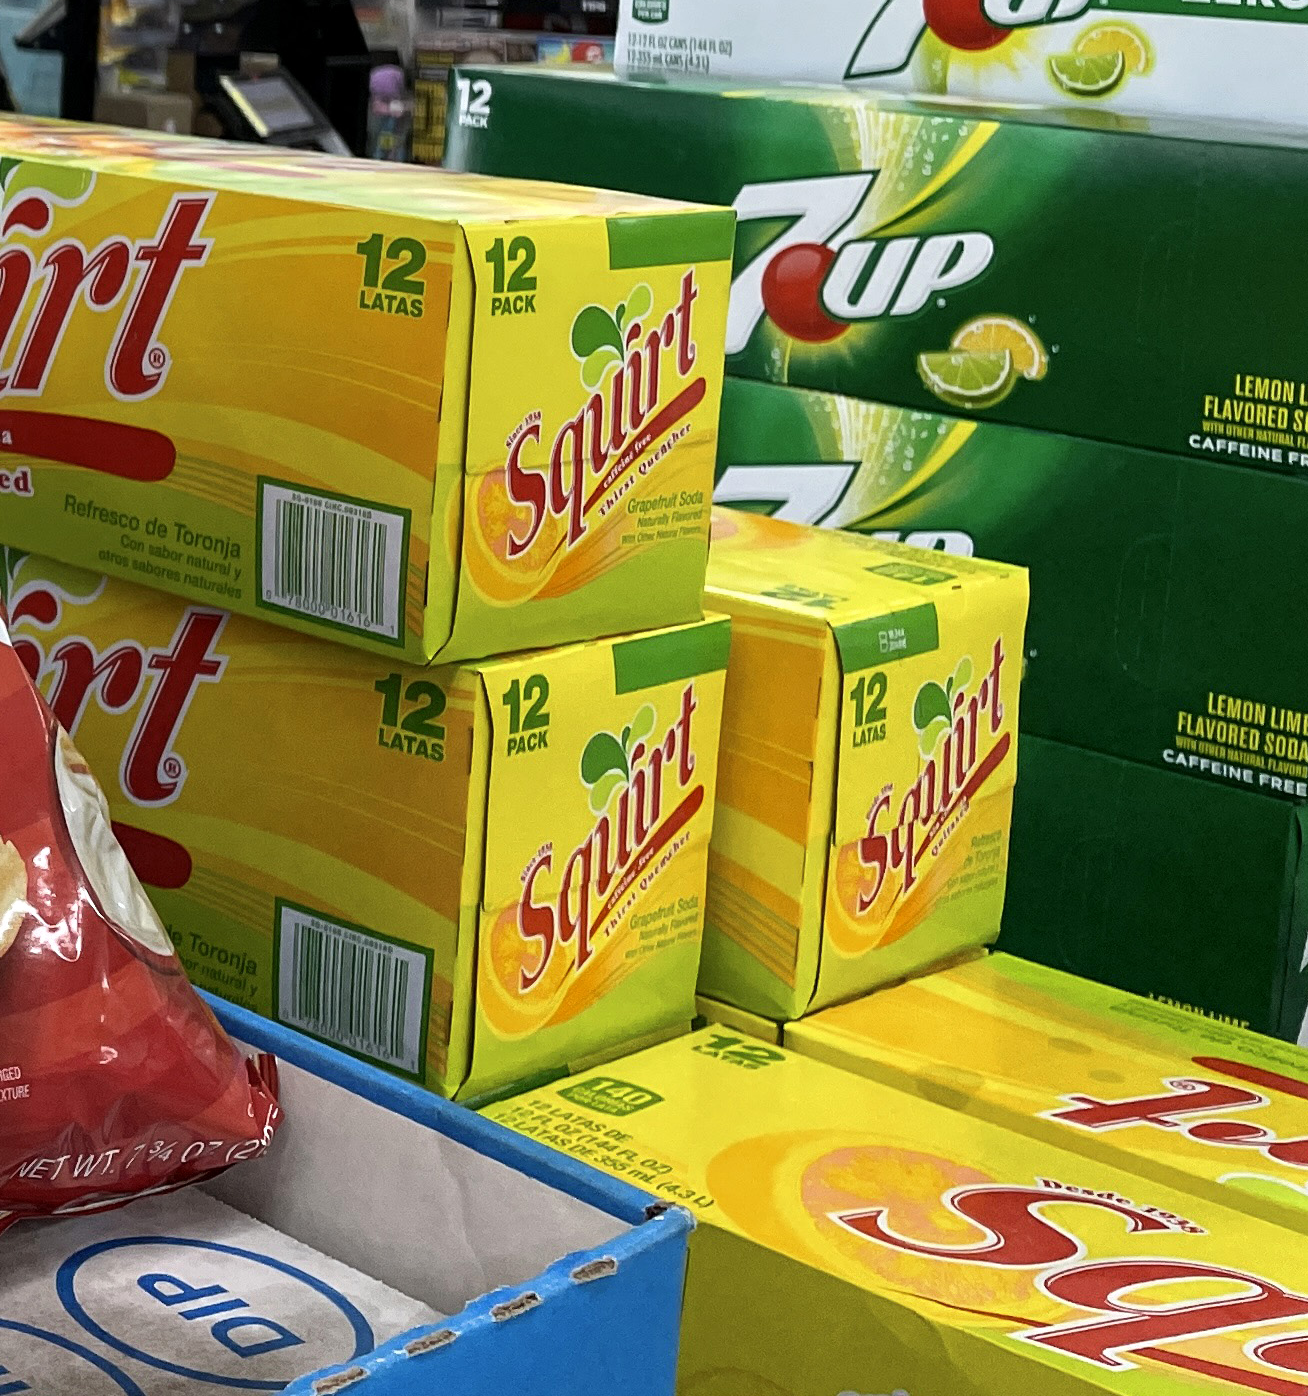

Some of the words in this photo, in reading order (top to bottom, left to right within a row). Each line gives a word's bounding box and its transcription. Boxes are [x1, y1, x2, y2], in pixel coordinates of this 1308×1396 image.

[458, 80, 492, 115] 12
[459, 114, 488, 129] PACK
[356, 233, 428, 294] 12
[485, 237, 538, 292] 12
[359, 289, 424, 318] LATAS
[490, 294, 536, 316] PACK
[1235, 373, 1295, 404] LEMON
[506, 267, 700, 560] Squirt
[1204, 394, 1289, 429] FLAVORED
[1188, 434, 1283, 463] CAFFEINE
[598, 474, 636, 516] Thirst
[638, 424, 692, 476] Quencher
[627, 492, 677, 515] Grapefruit
[679, 489, 704, 507] Soda
[64, 494, 140, 532] Refresco
[145, 517, 168, 540] de
[174, 521, 242, 561] Toronja
[98, 550, 129, 568] otros
[132, 555, 181, 582] sabores
[183, 569, 242, 600] naturales
[120, 534, 145, 553] Con
[148, 541, 184, 564] sabor
[186, 549, 232, 573] natural
[233, 566, 243, 582] y
[330, 607, 371, 628] 01616
[374, 672, 447, 737] 12
[502, 673, 551, 735] 12
[850, 671, 888, 727] 12
[1208, 691, 1266, 726] LEMON
[377, 729, 446, 762] LATAS
[507, 729, 549, 758] PACK
[853, 723, 887, 748] LATAS
[1177, 711, 1260, 751] FLAVORED
[1264, 732, 1308, 763] SODA
[856, 636, 1005, 914] Squirt
[1163, 748, 1254, 784] CAFFEINE
[1259, 772, 1308, 797] FREE
[519, 684, 697, 992] Squirt
[603, 893, 636, 938] Thirst
[189, 932, 258, 976] Toronja
[201, 964, 248, 993] natural
[593, 1080, 652, 1105] 140
[550, 1106, 607, 1134] LATAS
[10, 1153, 71, 1181] NET
[73, 1149, 120, 1179] WT.
[1040, 1178, 1133, 1207] Desde
[137, 1272, 306, 1360] DIP
